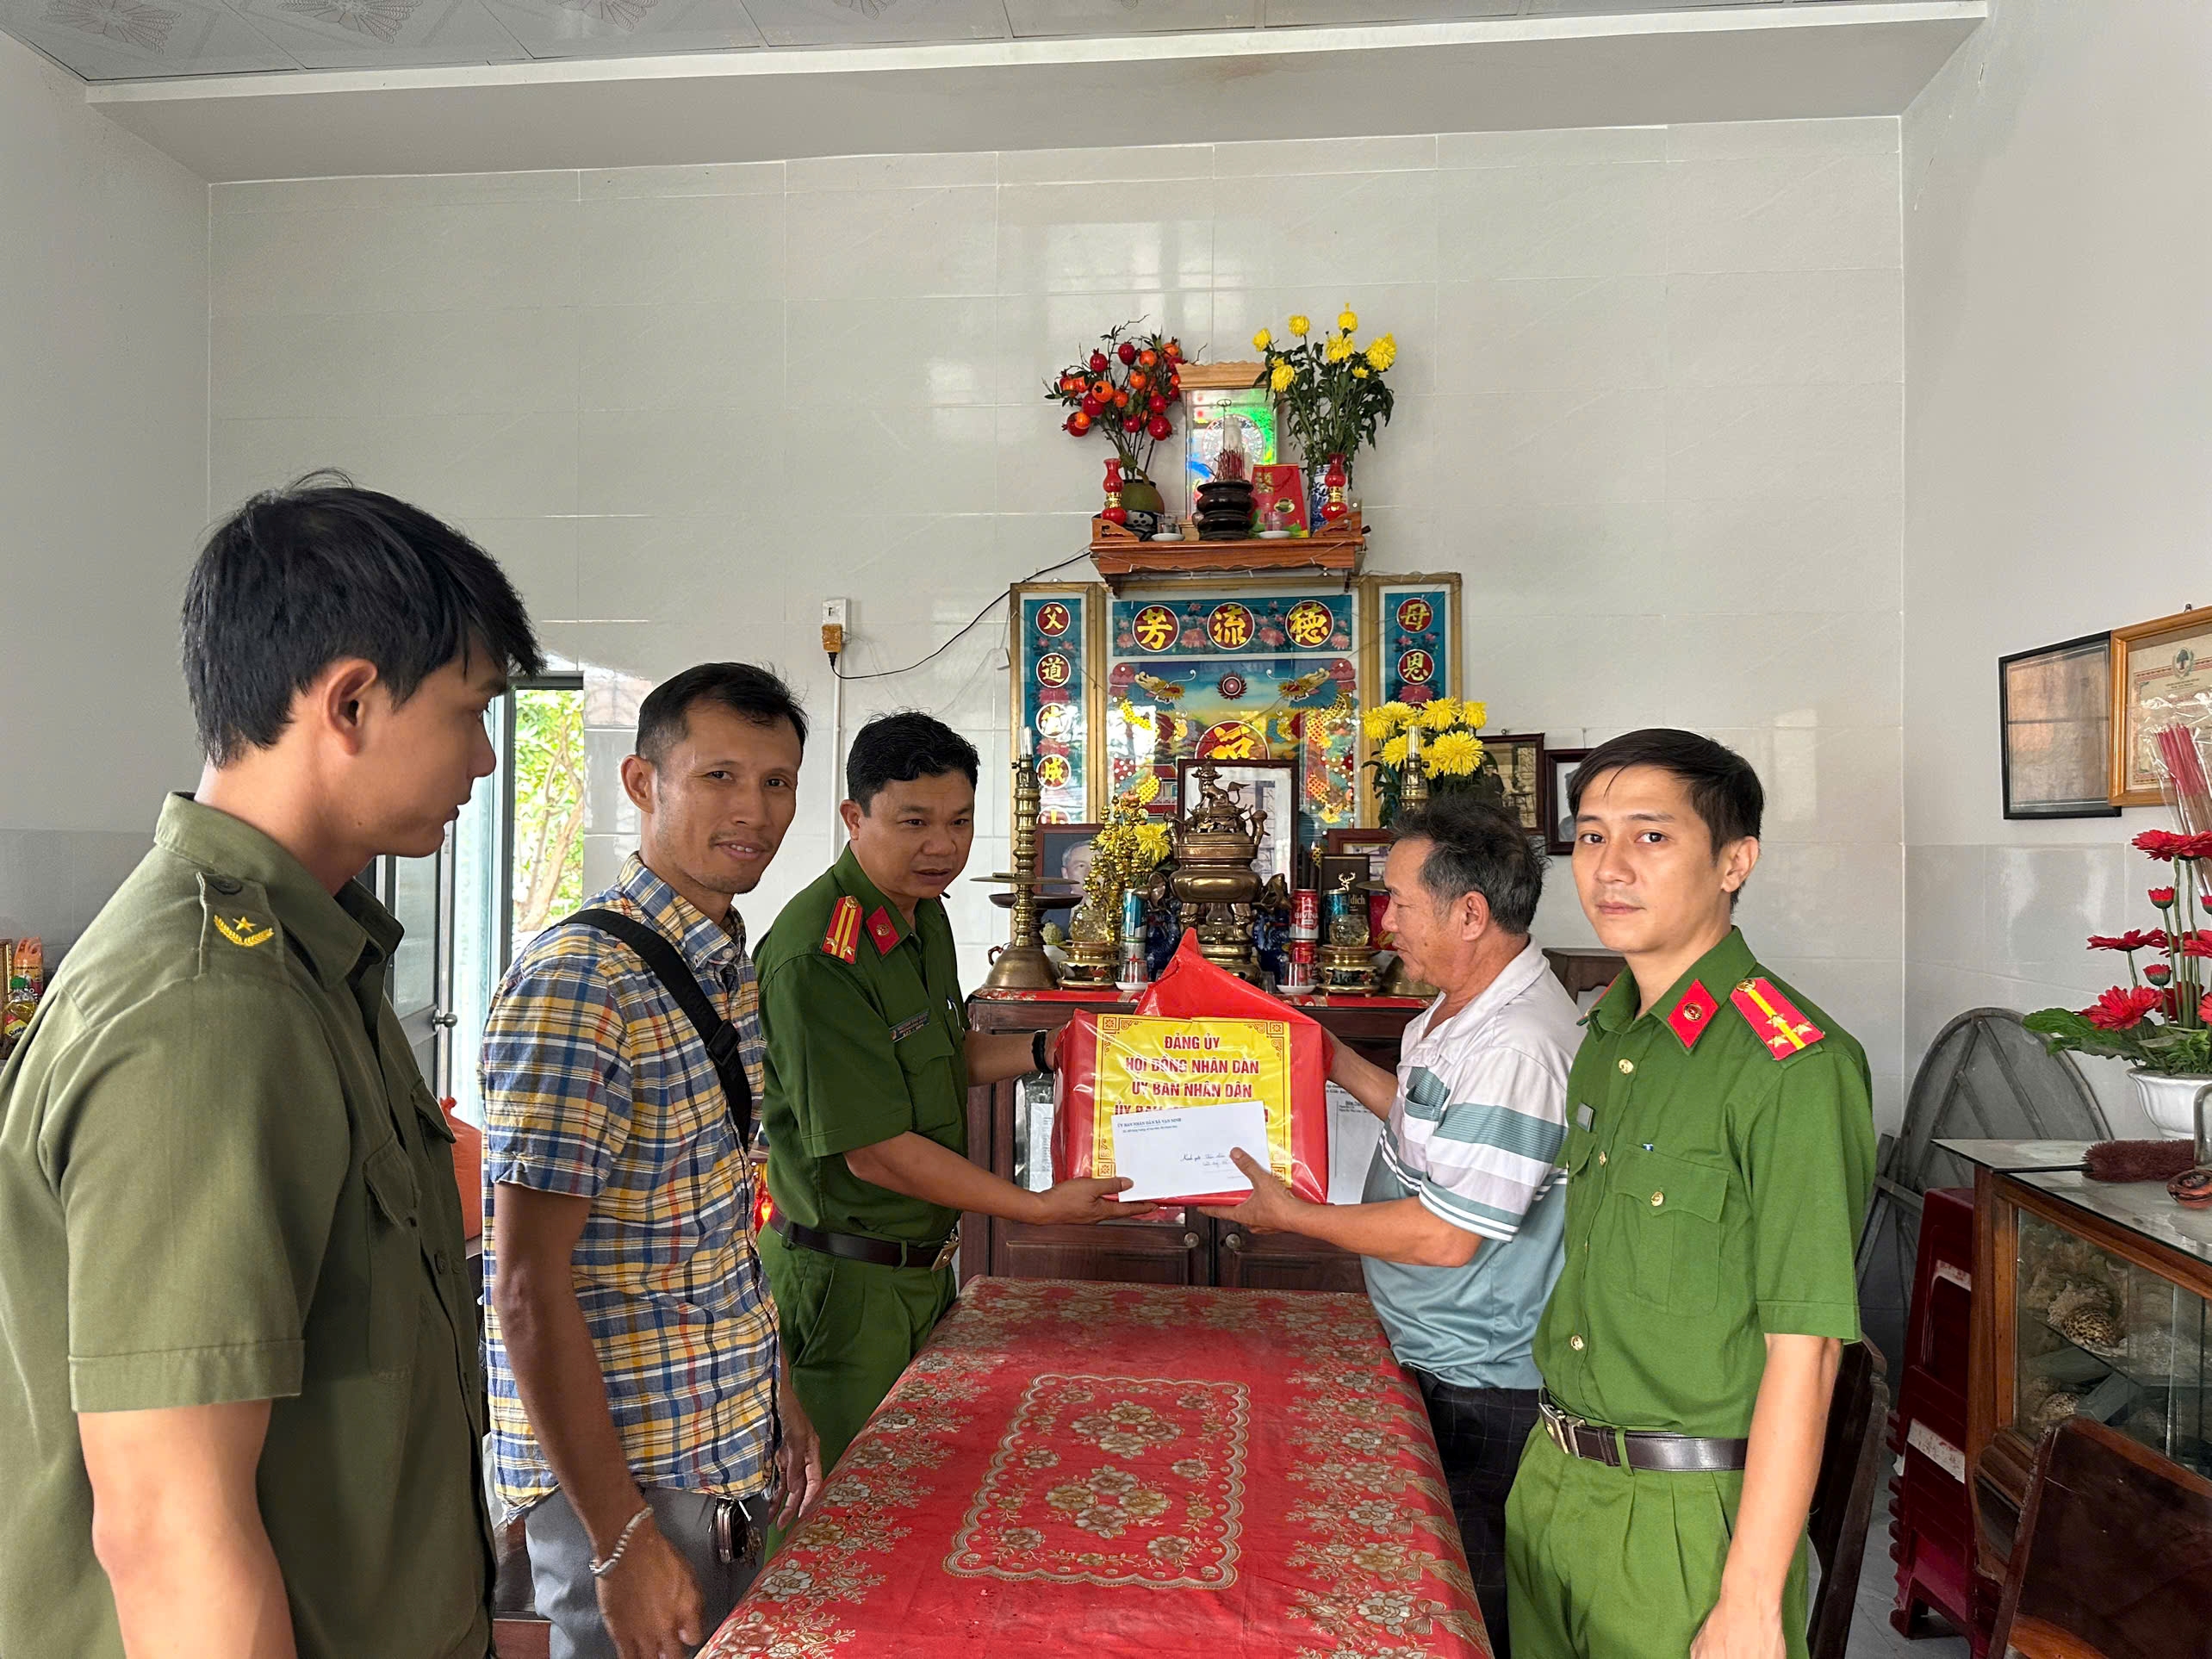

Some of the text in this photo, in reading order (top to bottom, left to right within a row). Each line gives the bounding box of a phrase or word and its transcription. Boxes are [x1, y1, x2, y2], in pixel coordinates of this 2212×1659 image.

[1164, 1033, 1221, 1049] ĐẢNG ỦY
[1126, 1054, 1147, 1074] HỘI
[1191, 1057, 1228, 1073] NHÂN
[1232, 1057, 1259, 1074] DÂN
[1153, 1083, 1180, 1097] BAN
[1184, 1080, 1221, 1097] NHÂN
[1225, 1080, 1252, 1098] DÂN
